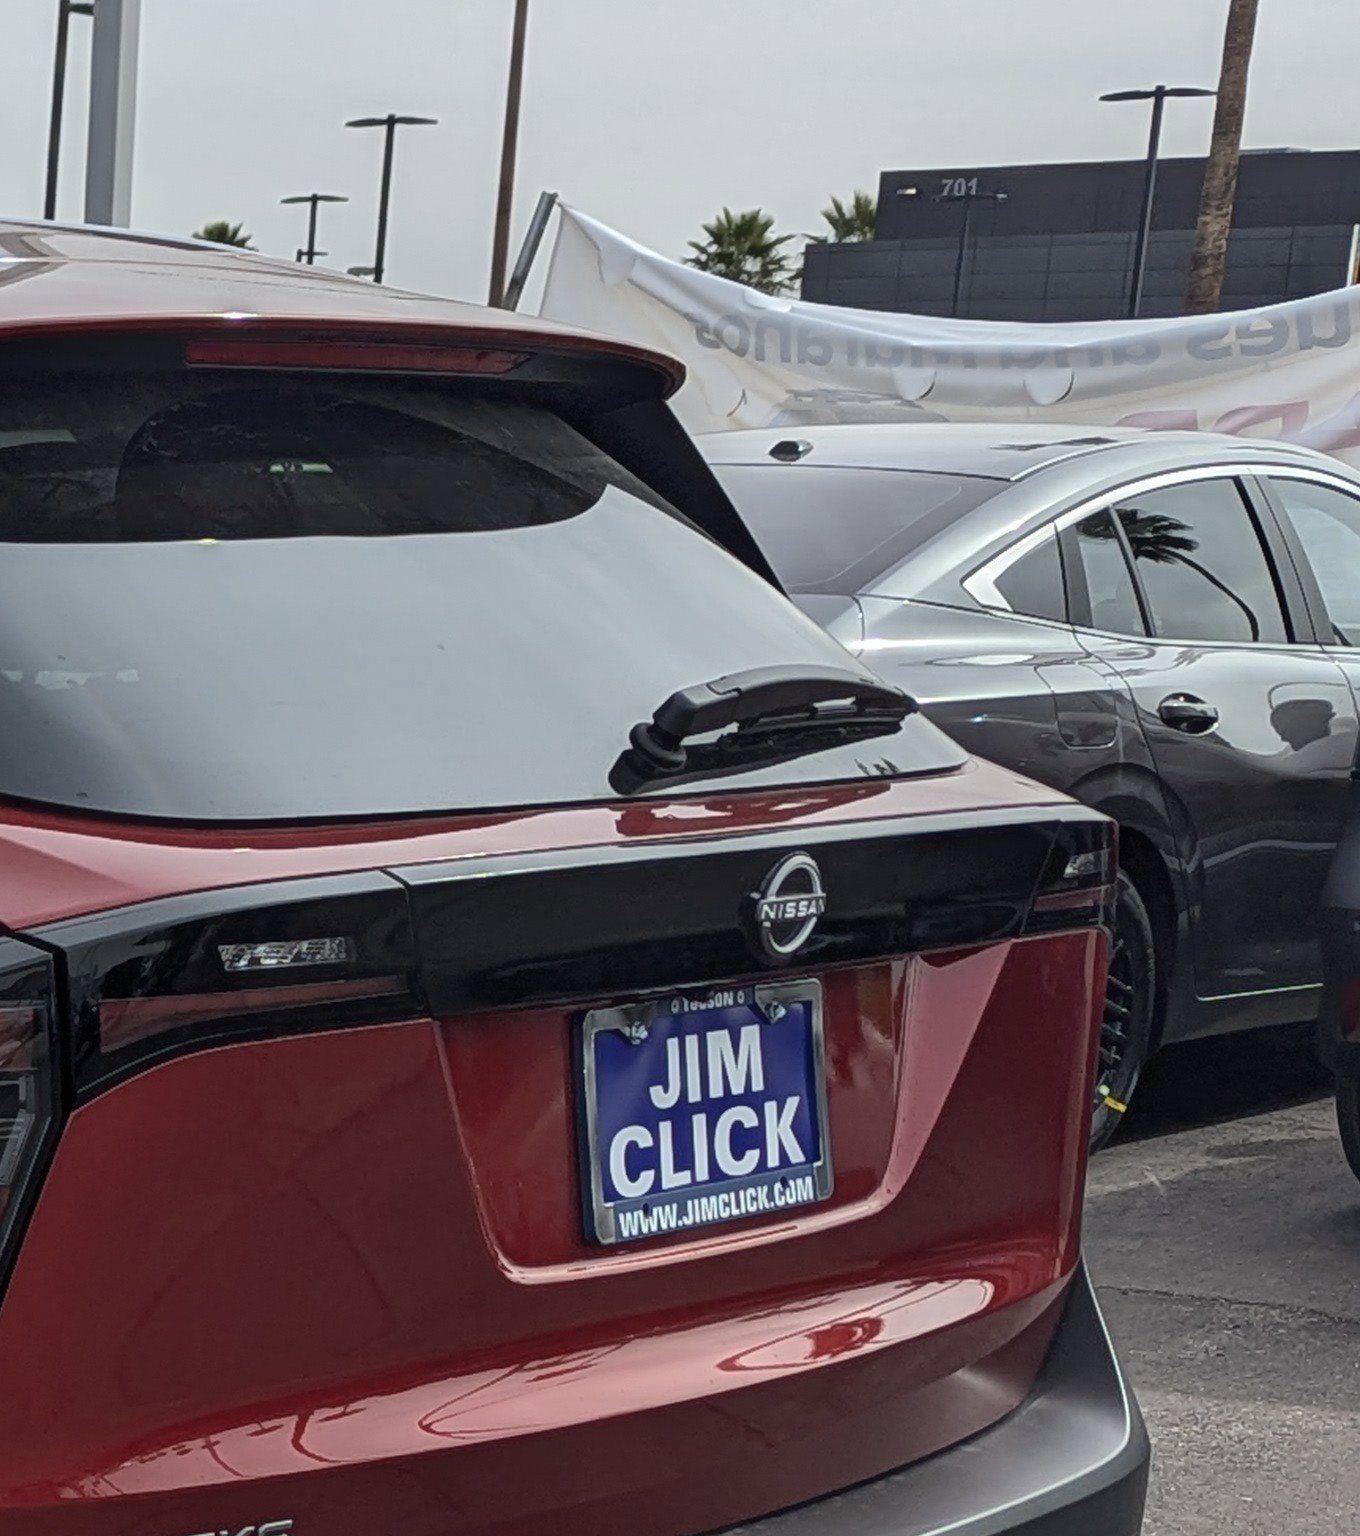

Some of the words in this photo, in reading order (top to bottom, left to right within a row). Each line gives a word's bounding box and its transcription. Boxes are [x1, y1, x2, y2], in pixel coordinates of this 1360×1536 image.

[941, 177, 978, 196] 701
[760, 896, 827, 921] NISSAN
[649, 1024, 765, 1109] JIM
[609, 1096, 806, 1198] CLICK
[619, 1176, 815, 1237] WWW.JIMCLICK.COM
